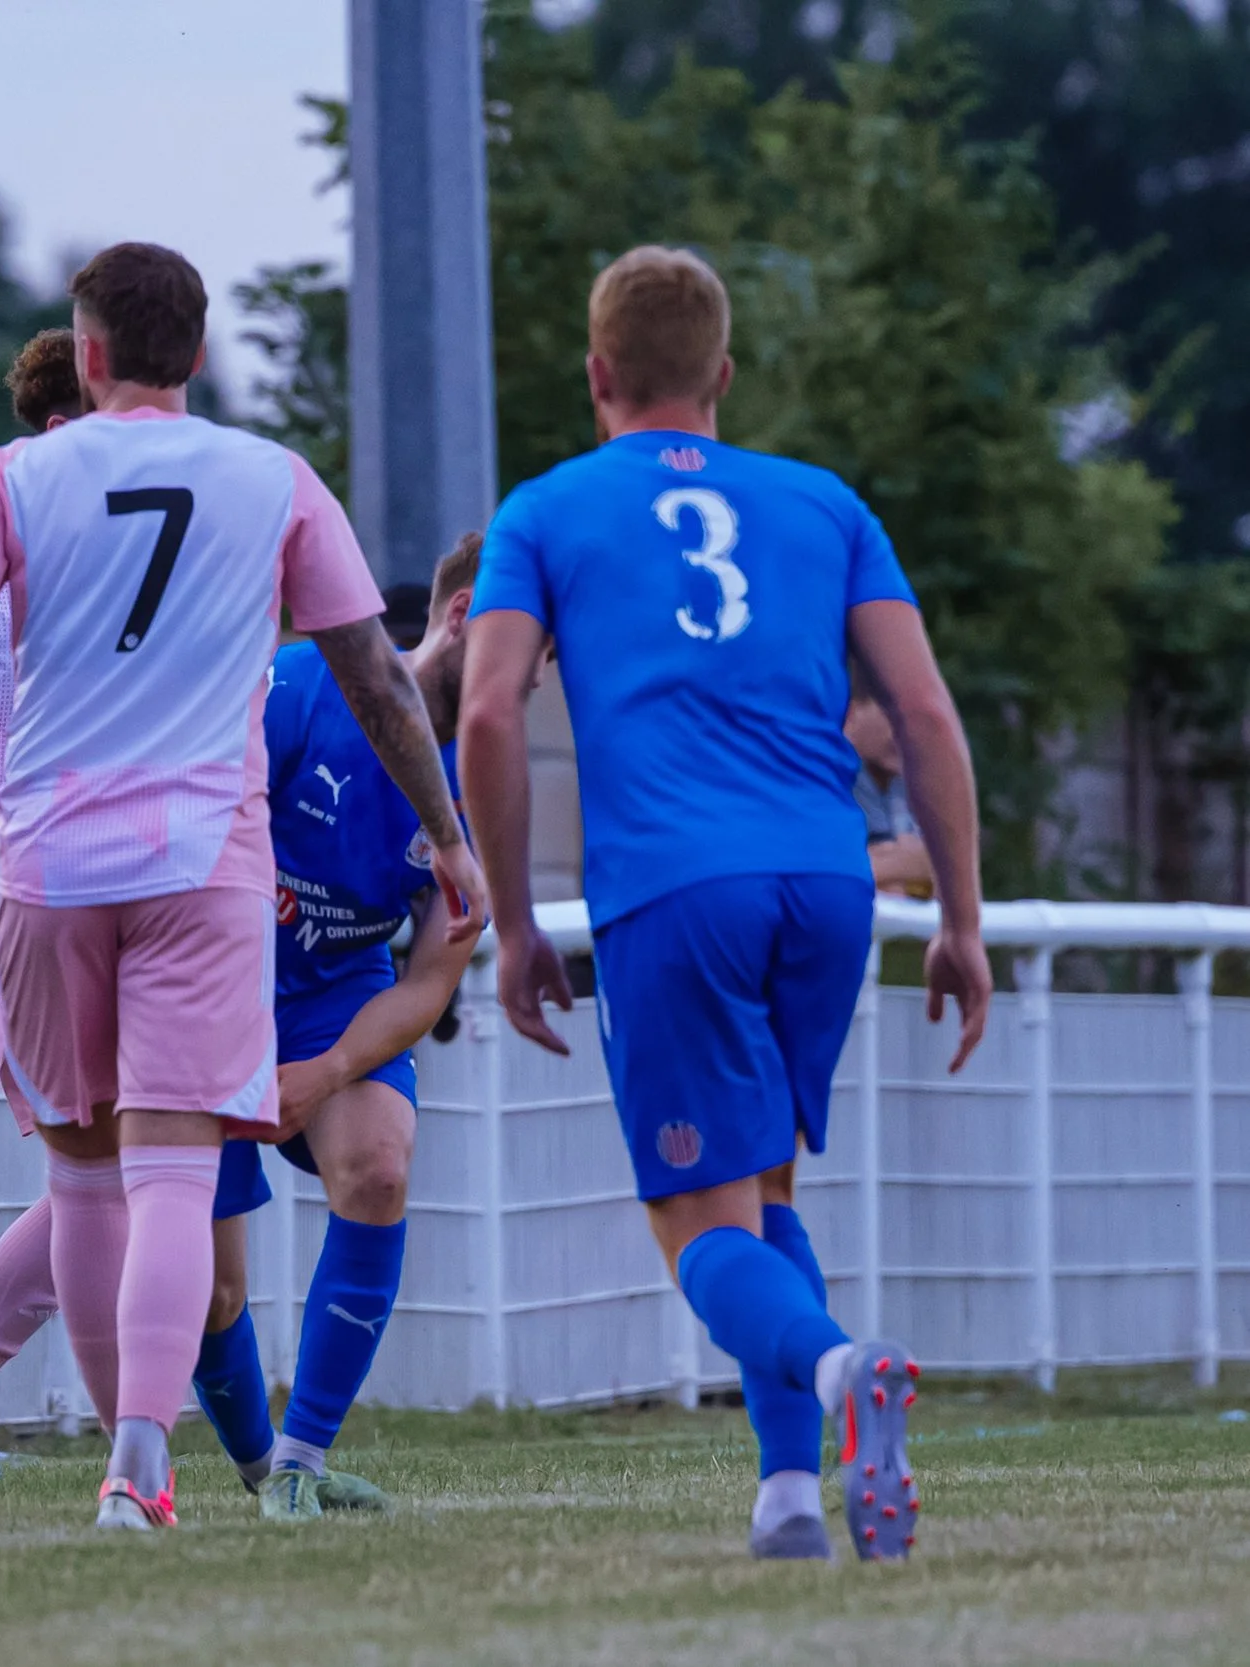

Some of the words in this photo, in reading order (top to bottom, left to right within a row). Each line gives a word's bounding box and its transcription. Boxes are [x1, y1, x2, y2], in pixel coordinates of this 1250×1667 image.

[104, 487, 195, 654] 7
[650, 486, 753, 643] 3
[276, 869, 330, 900] ENERAL
